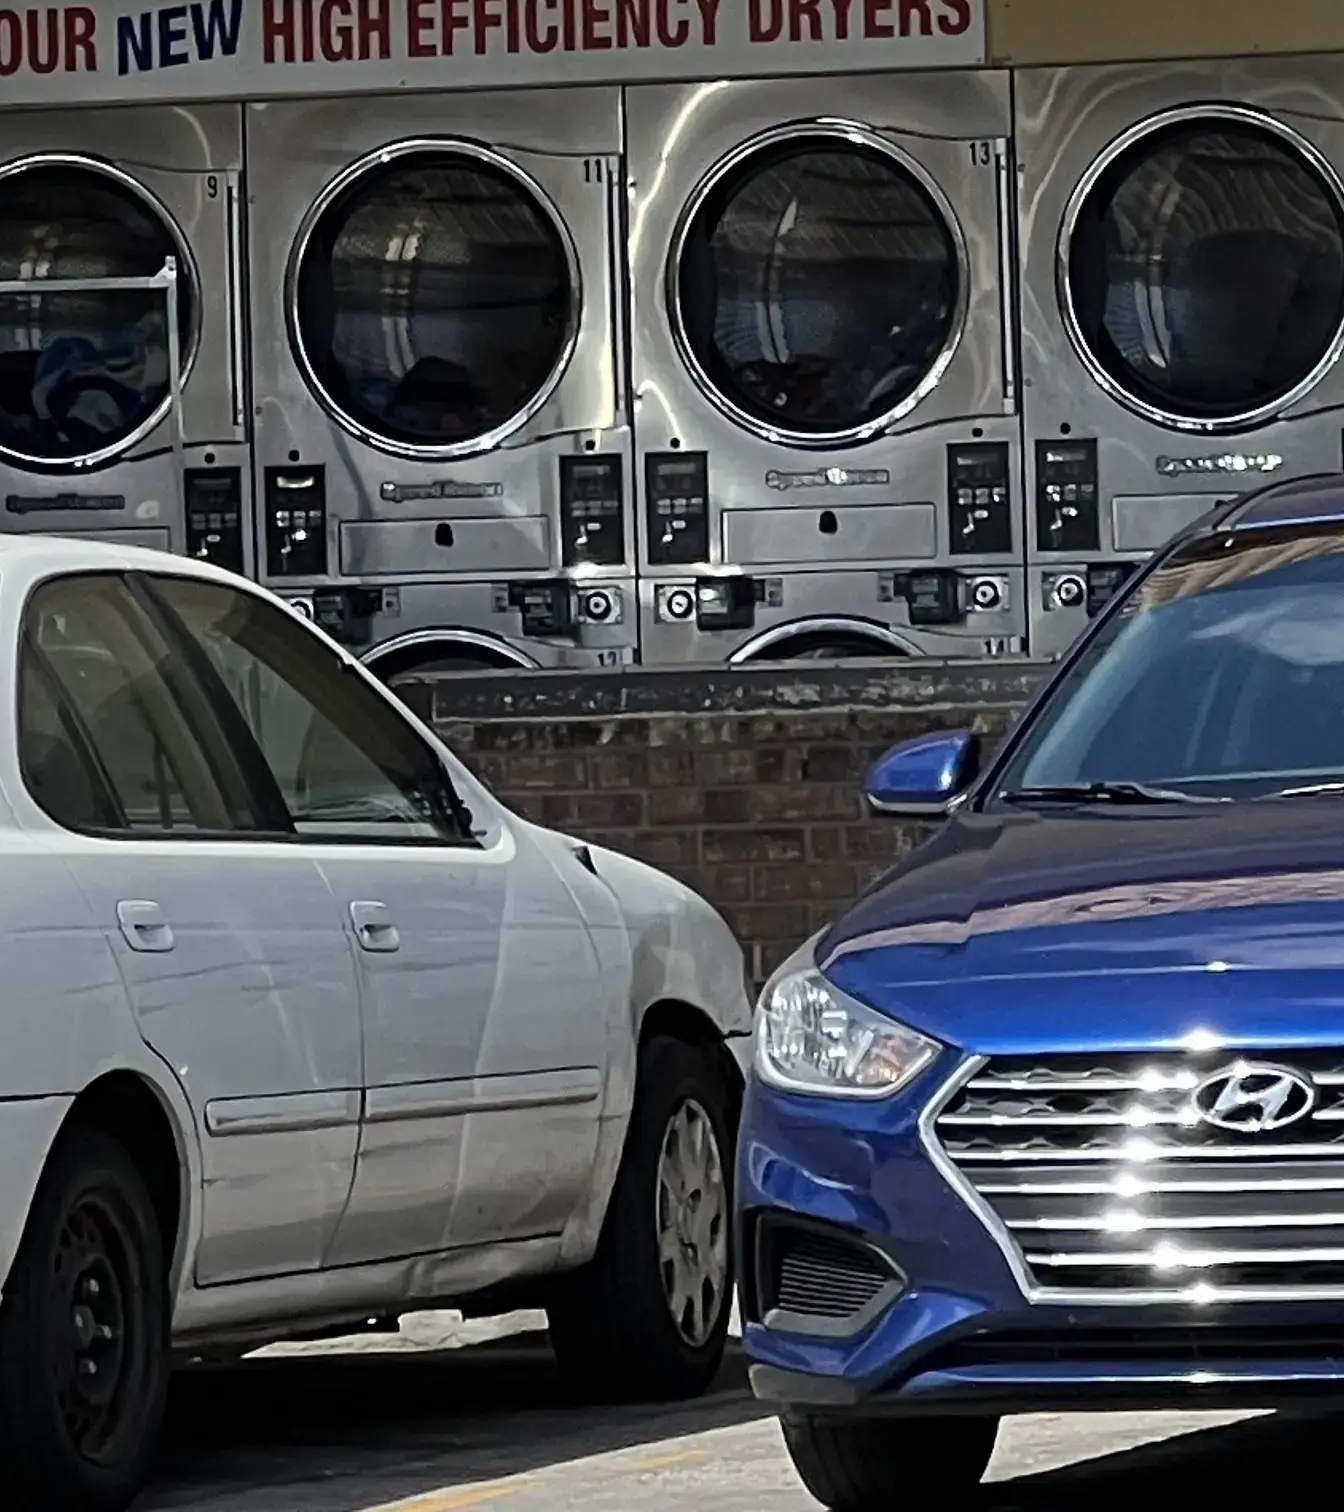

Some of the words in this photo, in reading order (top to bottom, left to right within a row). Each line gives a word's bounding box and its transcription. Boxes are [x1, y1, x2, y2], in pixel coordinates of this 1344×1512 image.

[969, 141, 993, 166] 13
[583, 159, 604, 183] 11
[206, 175, 217, 199] 9
